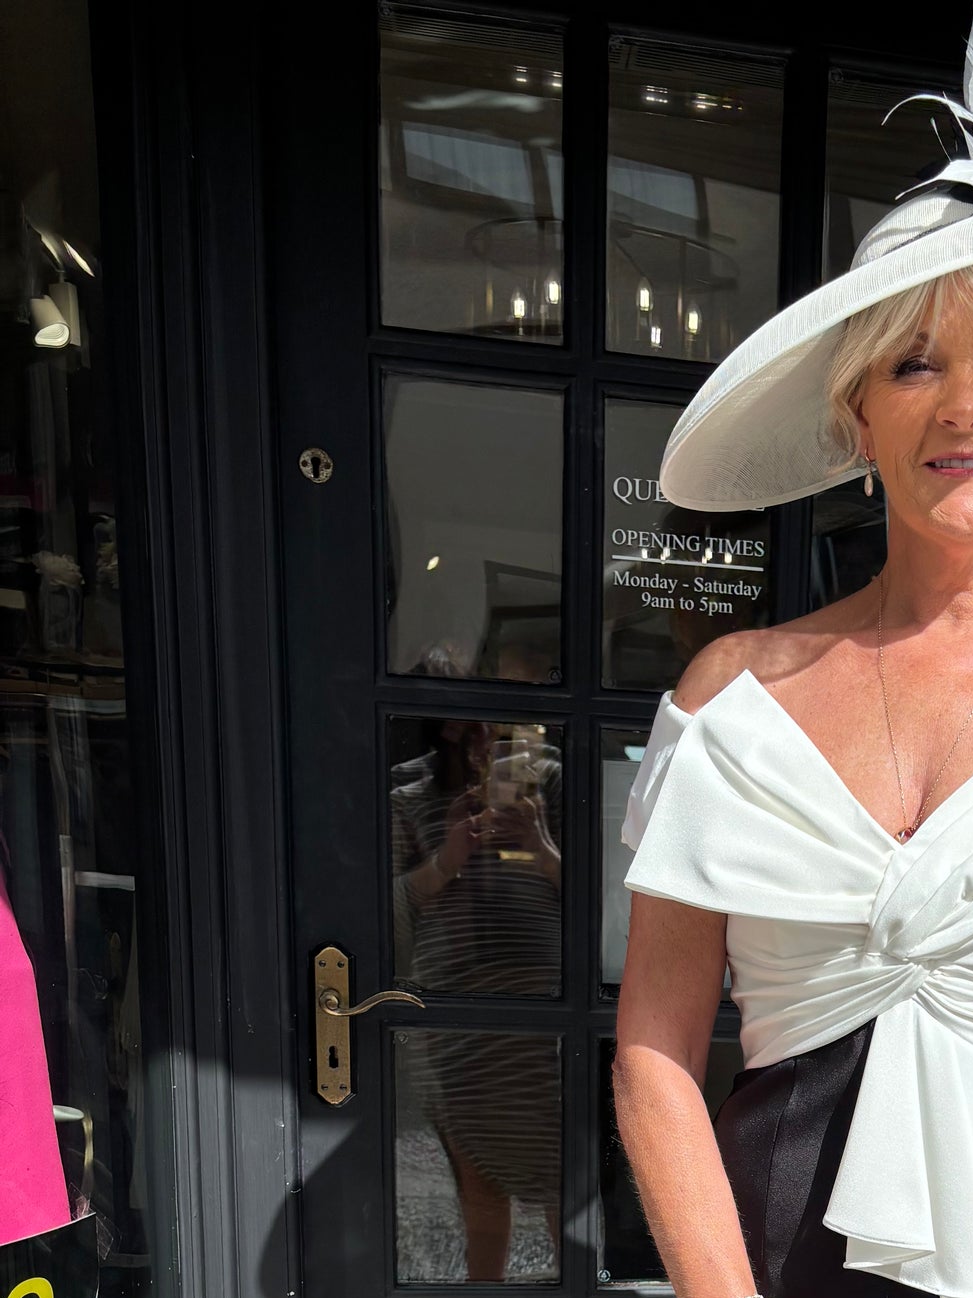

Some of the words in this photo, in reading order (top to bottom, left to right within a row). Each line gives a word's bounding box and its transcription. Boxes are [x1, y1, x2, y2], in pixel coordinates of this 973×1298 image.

[611, 528, 701, 551] OPENING
[704, 537, 765, 557] TIMES
[612, 570, 678, 594] Monday
[693, 577, 762, 600] Saturday
[641, 592, 675, 609] 9am
[679, 596, 694, 611] to
[699, 597, 733, 616] 5pm
